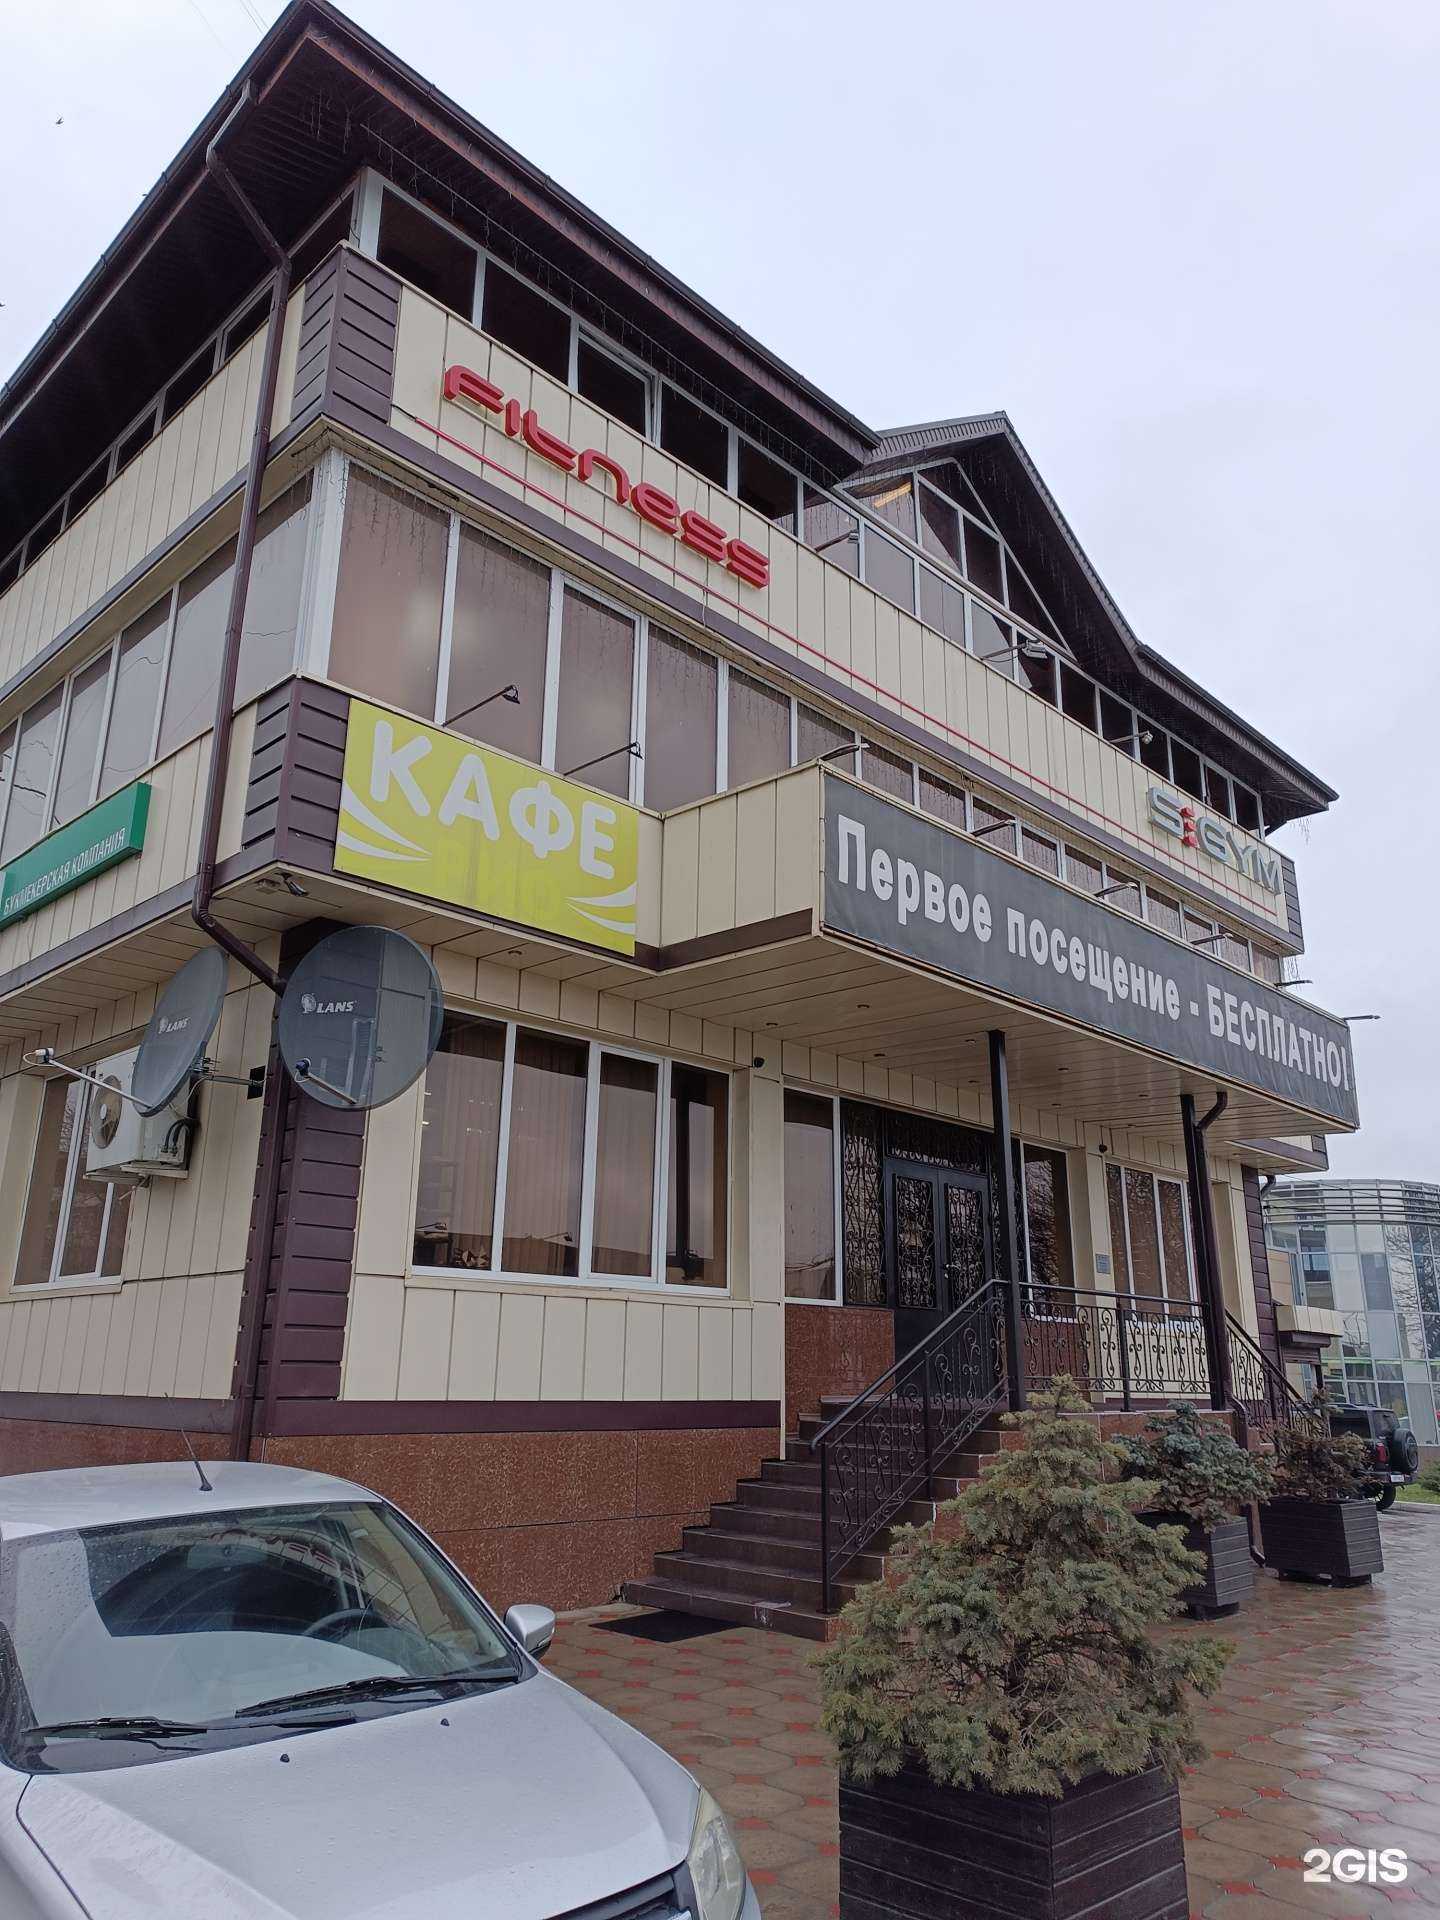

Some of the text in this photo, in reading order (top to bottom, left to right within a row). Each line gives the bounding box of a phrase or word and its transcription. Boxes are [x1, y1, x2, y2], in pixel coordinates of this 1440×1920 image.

[443, 364, 770, 589] Fitness
[3, 827, 126, 916] БУКМЕКЕРСКАЯ КОМПАНИЯ
[369, 720, 617, 879] КАФЕ
[316, 1000, 355, 1014] LANS
[838, 814, 992, 943] Первое
[1007, 907, 1180, 1020] посещение
[1207, 983, 1350, 1092] БЕСПЛАТНО!
